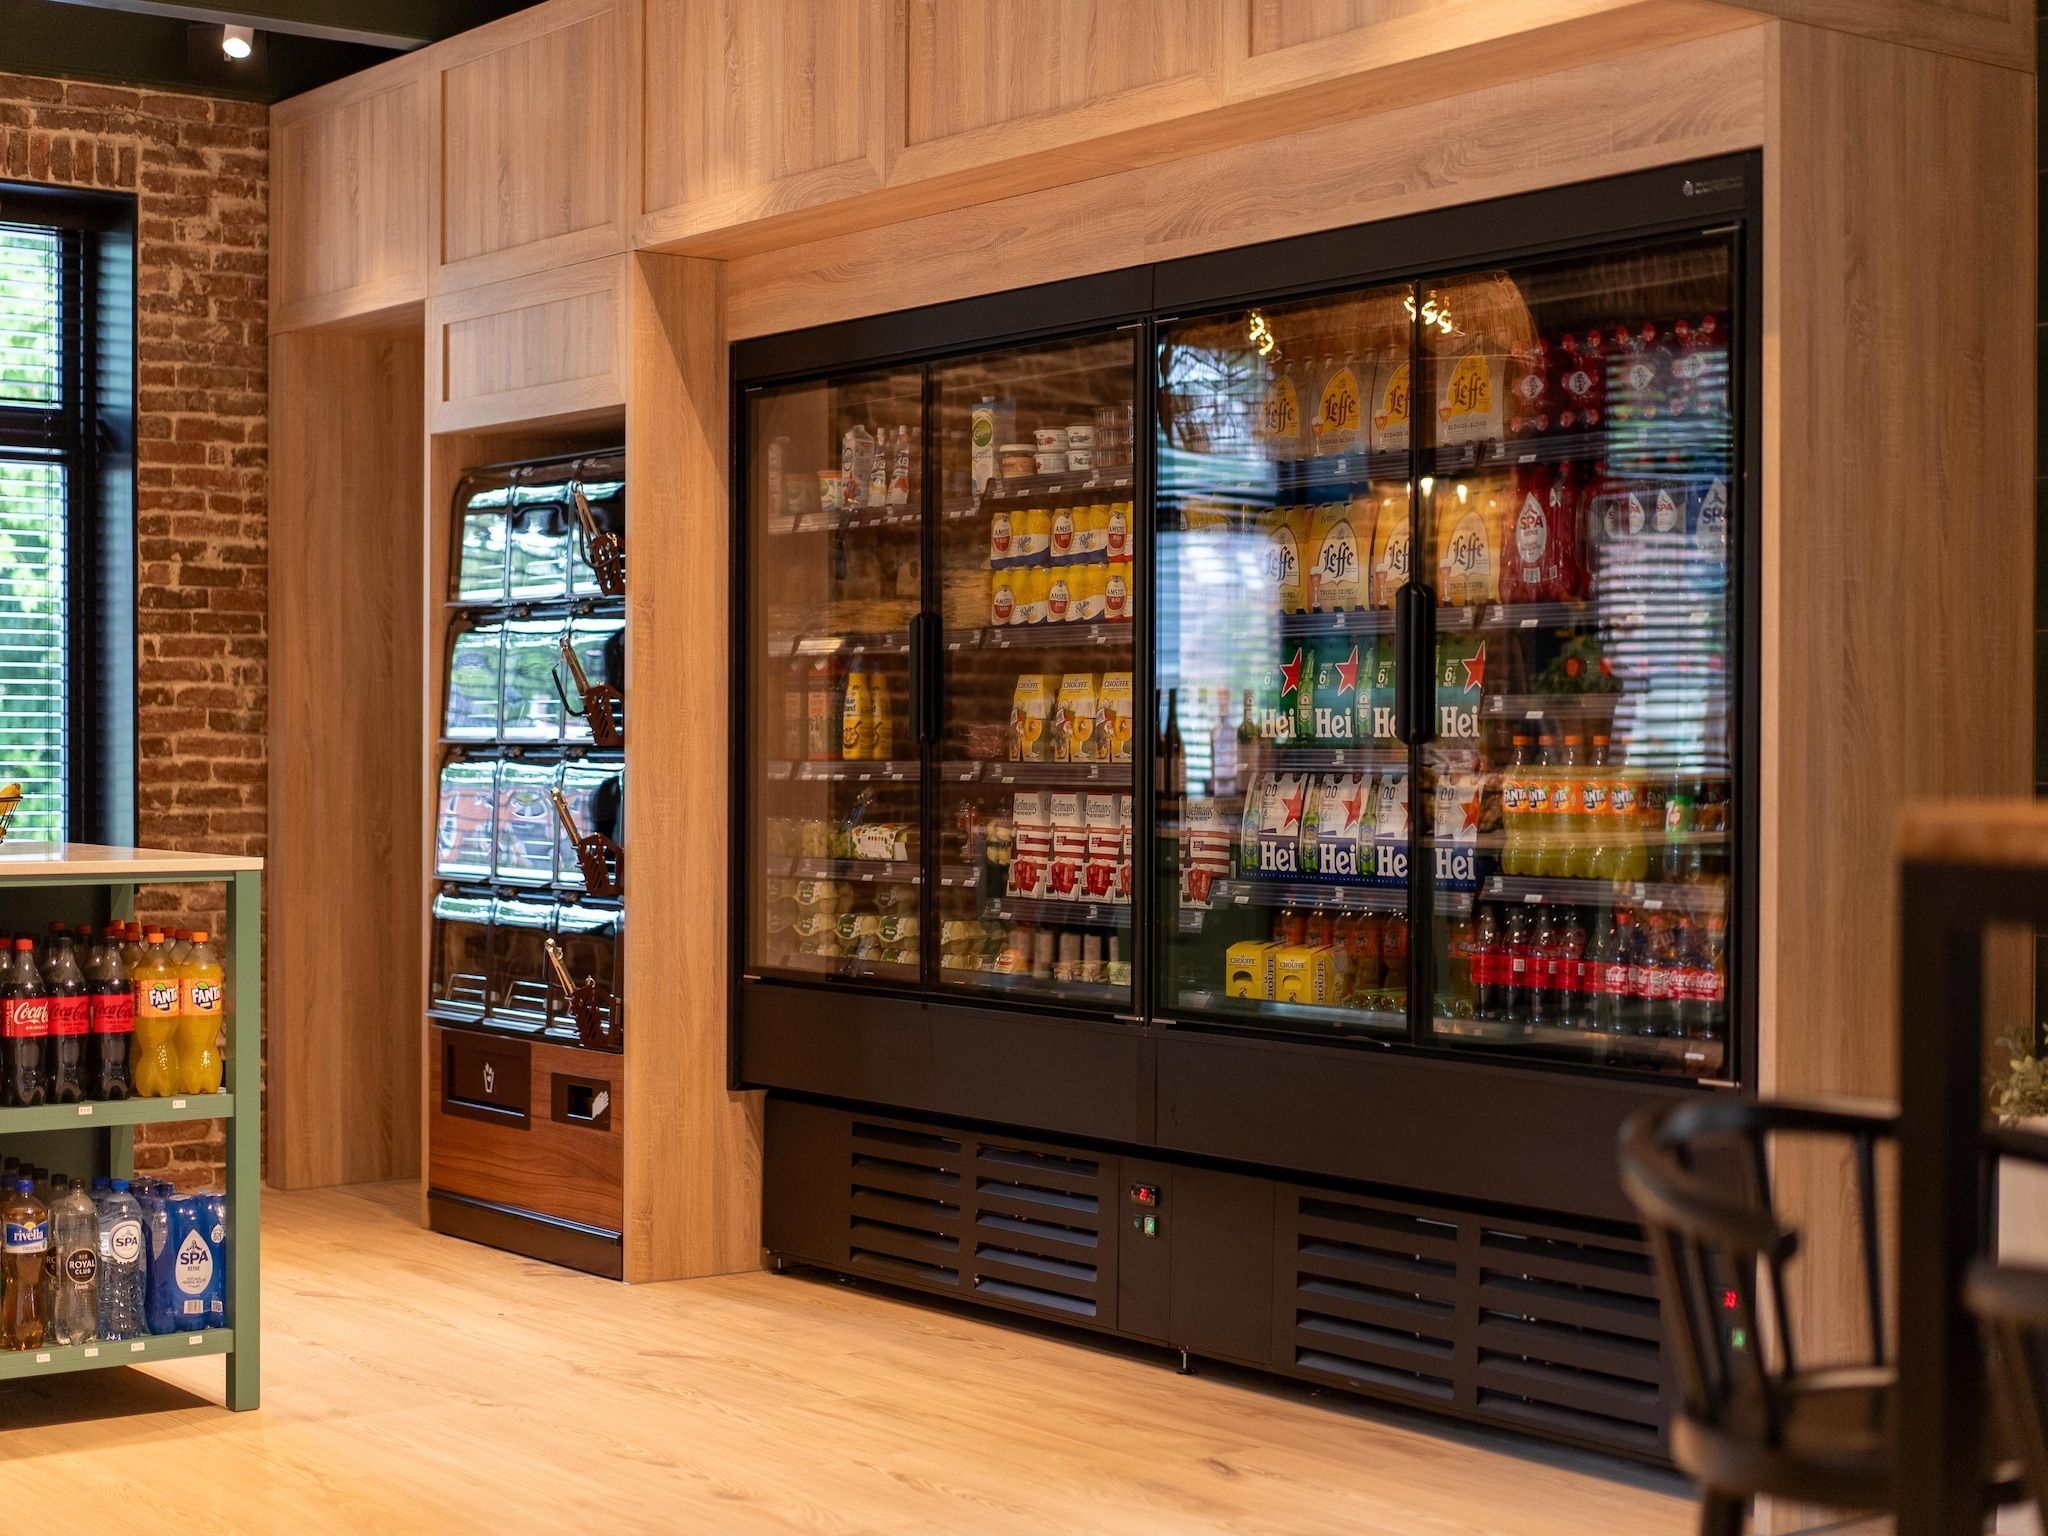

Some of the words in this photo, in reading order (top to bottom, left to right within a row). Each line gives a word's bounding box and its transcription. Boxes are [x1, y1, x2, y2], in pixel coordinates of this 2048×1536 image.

[1452, 371, 1487, 411] Leffe
[1264, 398, 1294, 434] Leffe
[1323, 389, 1356, 427] Leffe
[1520, 515, 1544, 530] SPA
[1703, 506, 1722, 524] SP
[1264, 545, 1295, 582] Leffe
[1322, 541, 1354, 579] Leffe
[1453, 532, 1485, 572] Leffe
[1319, 670, 1327, 685] 6
[1260, 708, 1297, 738] Hei
[1315, 707, 1353, 738] Hei
[1440, 705, 1480, 738] Hei
[1504, 787, 1529, 802] FANTA
[1260, 840, 1298, 872] Hei
[1319, 843, 1358, 875] Hei
[1434, 847, 1476, 880] Hei
[1230, 957, 1256, 965] CHOUFFE
[1280, 961, 1305, 969] CHOUFFE
[13, 1228, 44, 1241] rivella
[115, 1237, 138, 1248] SPA
[69, 1261, 96, 1270] ROYAL
[74, 1268, 92, 1276] CLUB
[180, 1250, 209, 1266] SPA
